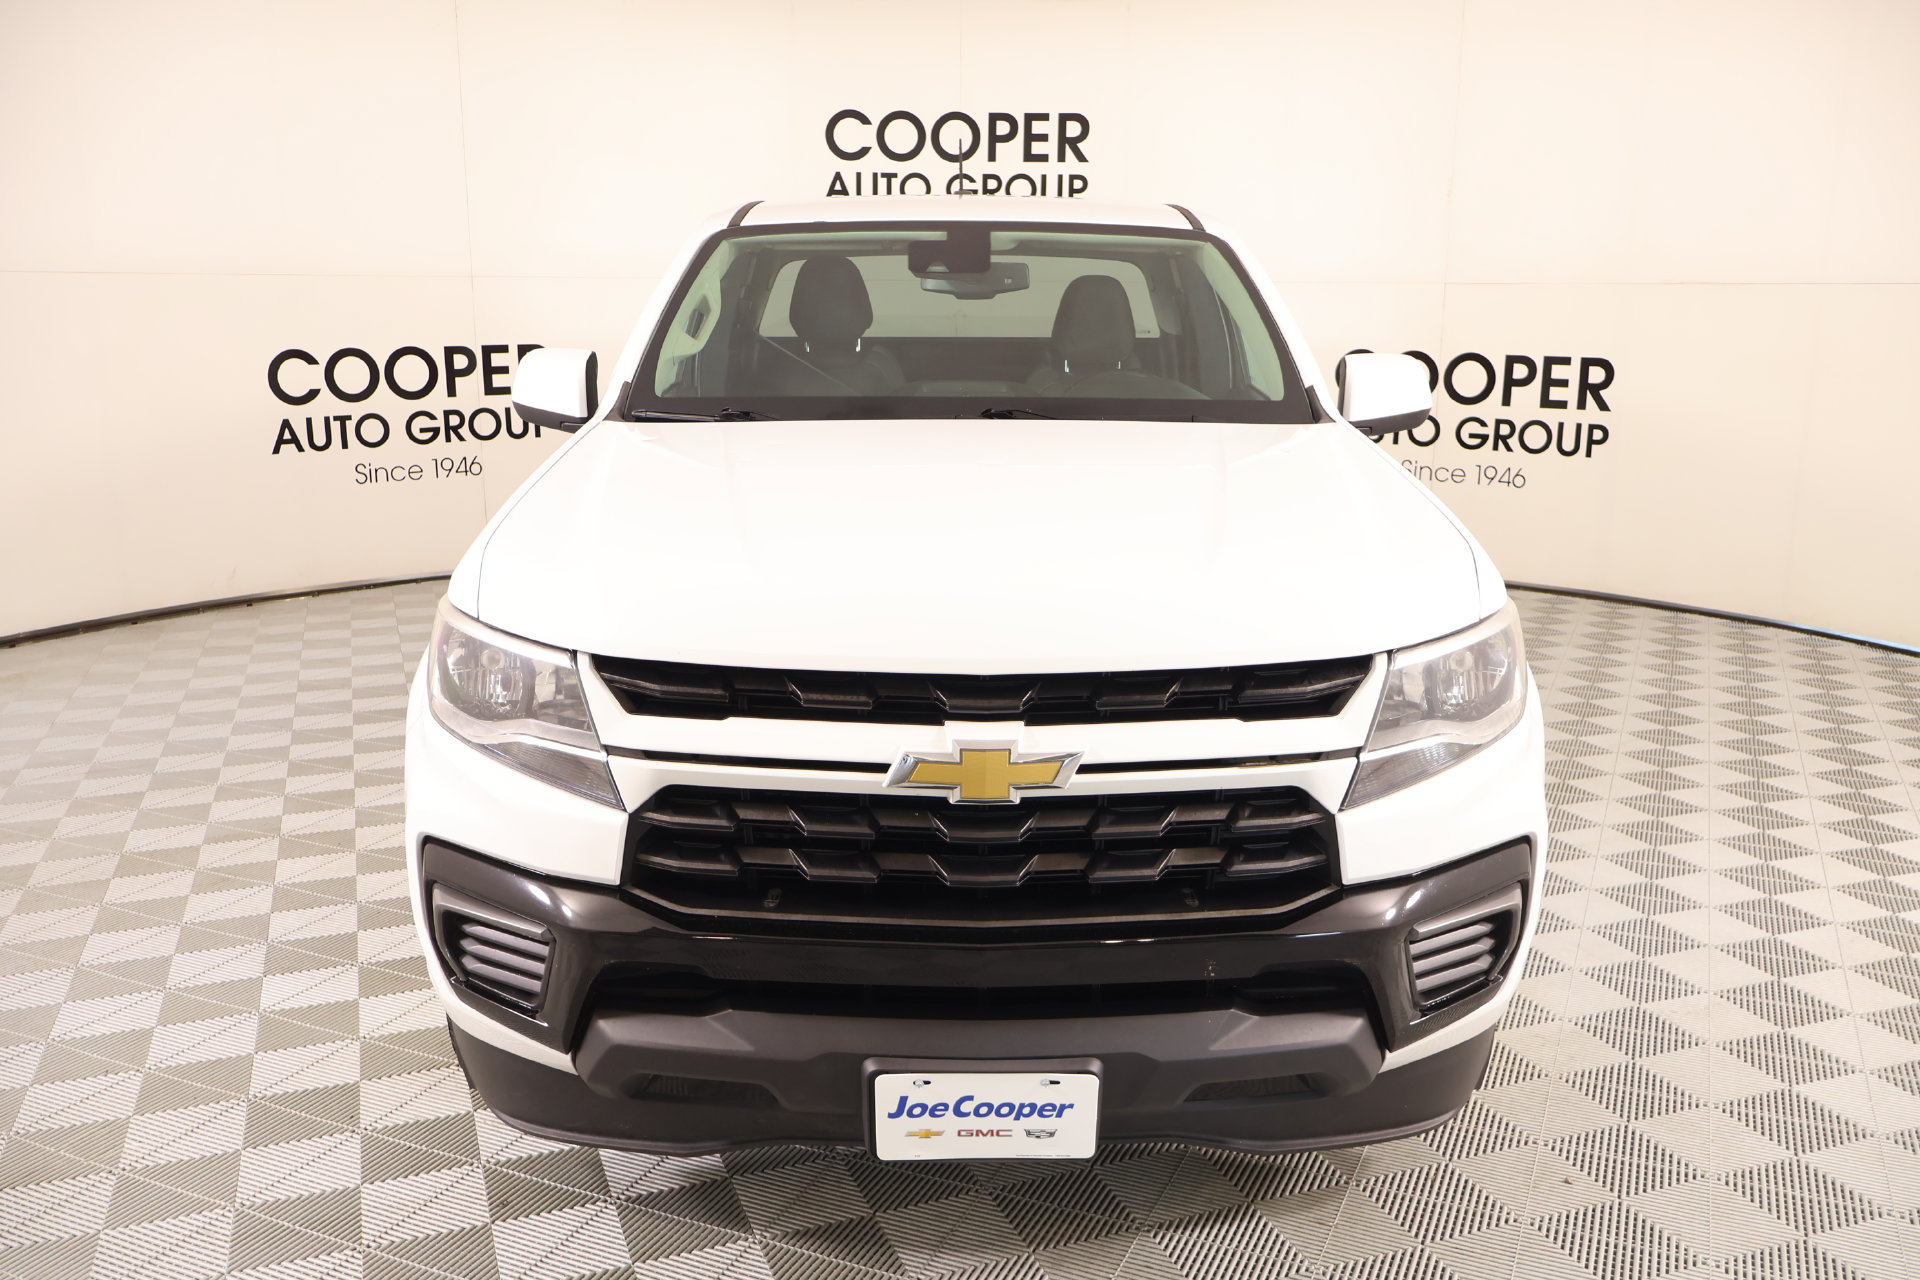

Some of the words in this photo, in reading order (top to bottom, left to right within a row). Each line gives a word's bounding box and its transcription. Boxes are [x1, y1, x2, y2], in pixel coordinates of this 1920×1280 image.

[825, 108, 1090, 163] COOPER
[826, 171, 931, 197] AUTO
[946, 173, 1089, 198] GROUP
[267, 344, 545, 406] COOPE
[1335, 348, 1615, 412] OPER
[272, 412, 390, 455] AUTO
[1455, 416, 1609, 458] GROUP
[355, 462, 424, 484] Since
[432, 456, 482, 479] 1946
[1401, 459, 1466, 484] Since
[1475, 464, 1526, 488] 1946
[887, 1095, 950, 1119] Joe
[952, 1095, 1075, 1121] Cooper
[957, 1129, 1013, 1138] GMC
